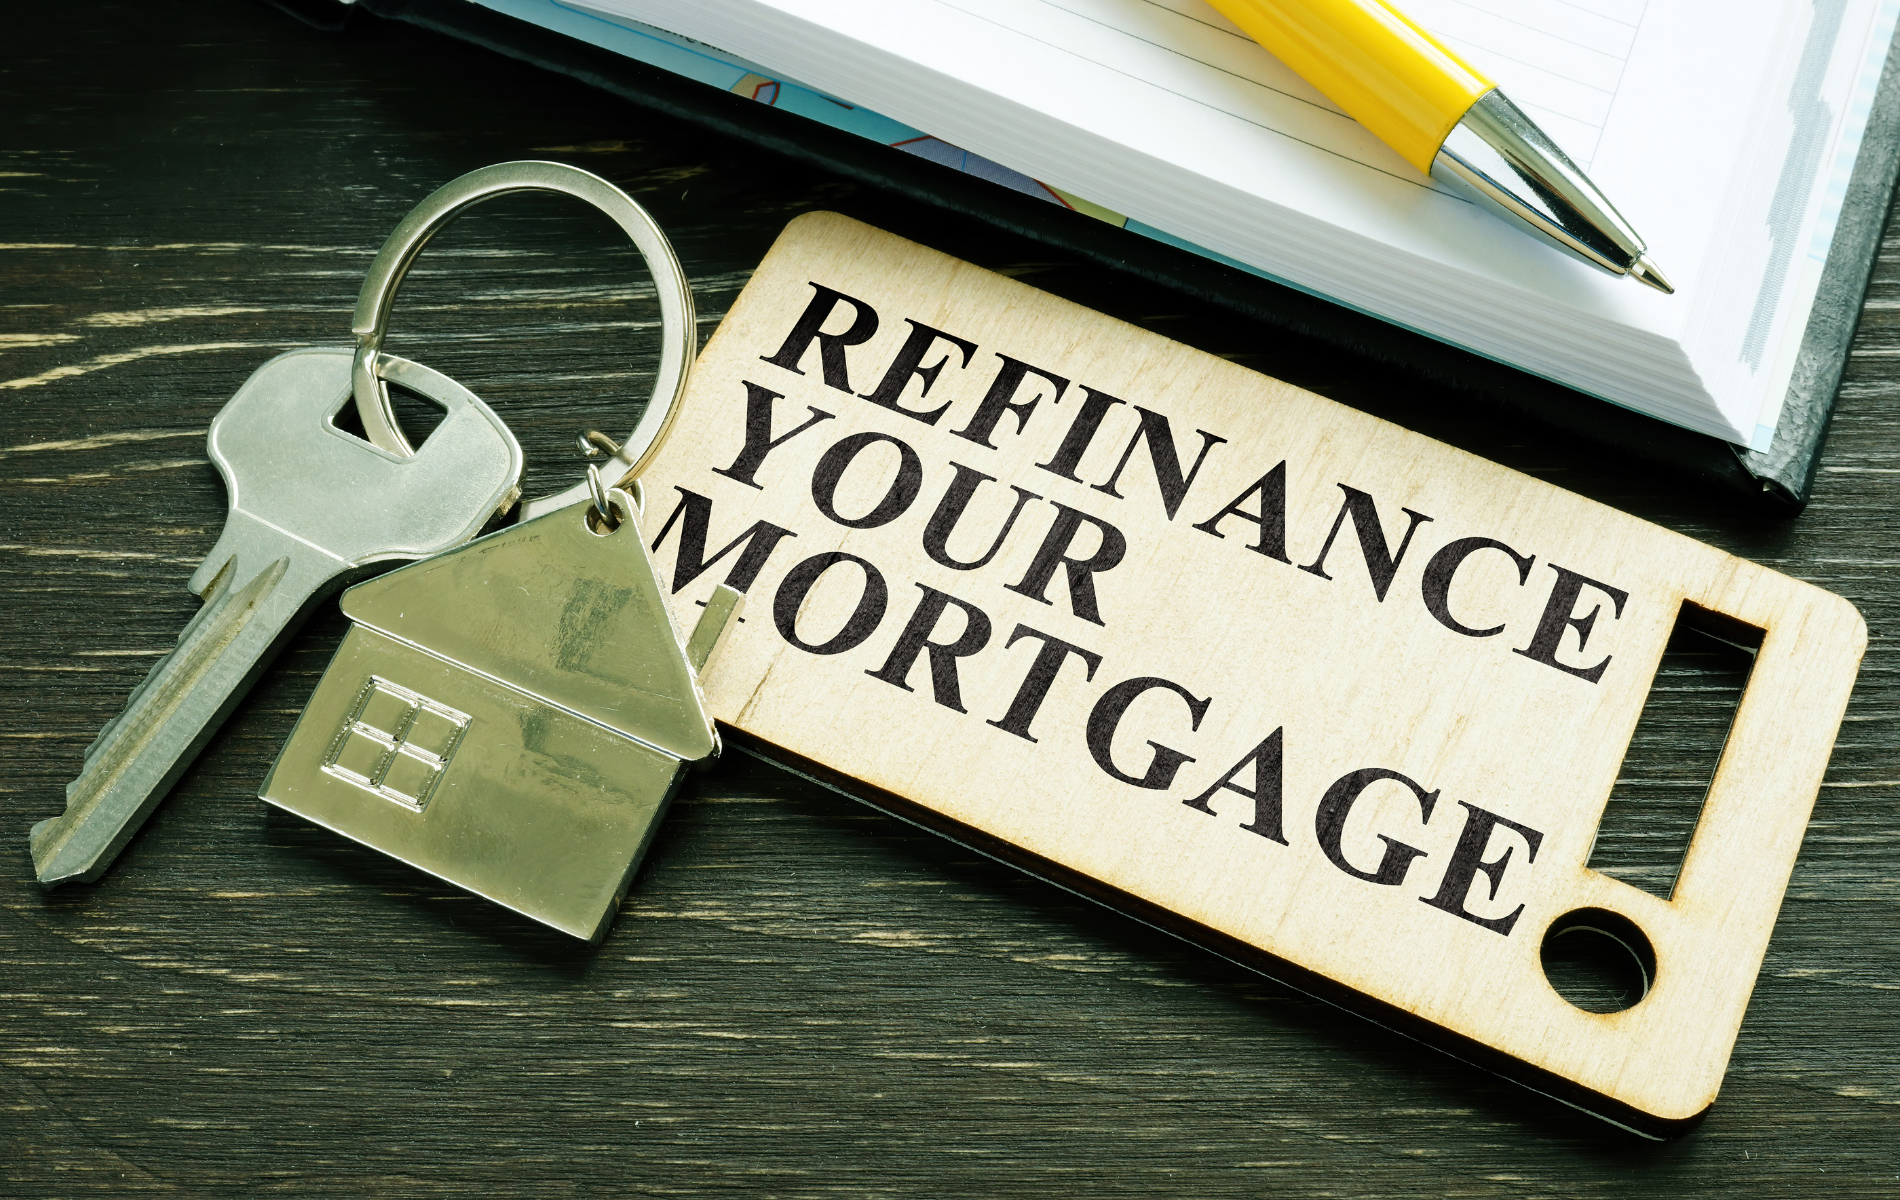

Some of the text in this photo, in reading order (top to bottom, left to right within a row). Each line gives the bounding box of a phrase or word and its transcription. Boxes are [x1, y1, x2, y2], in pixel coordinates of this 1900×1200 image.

[711, 379, 1127, 628] YOUR
[759, 280, 1629, 685] REFINANCE
[650, 485, 1545, 937] MORTGAGE
